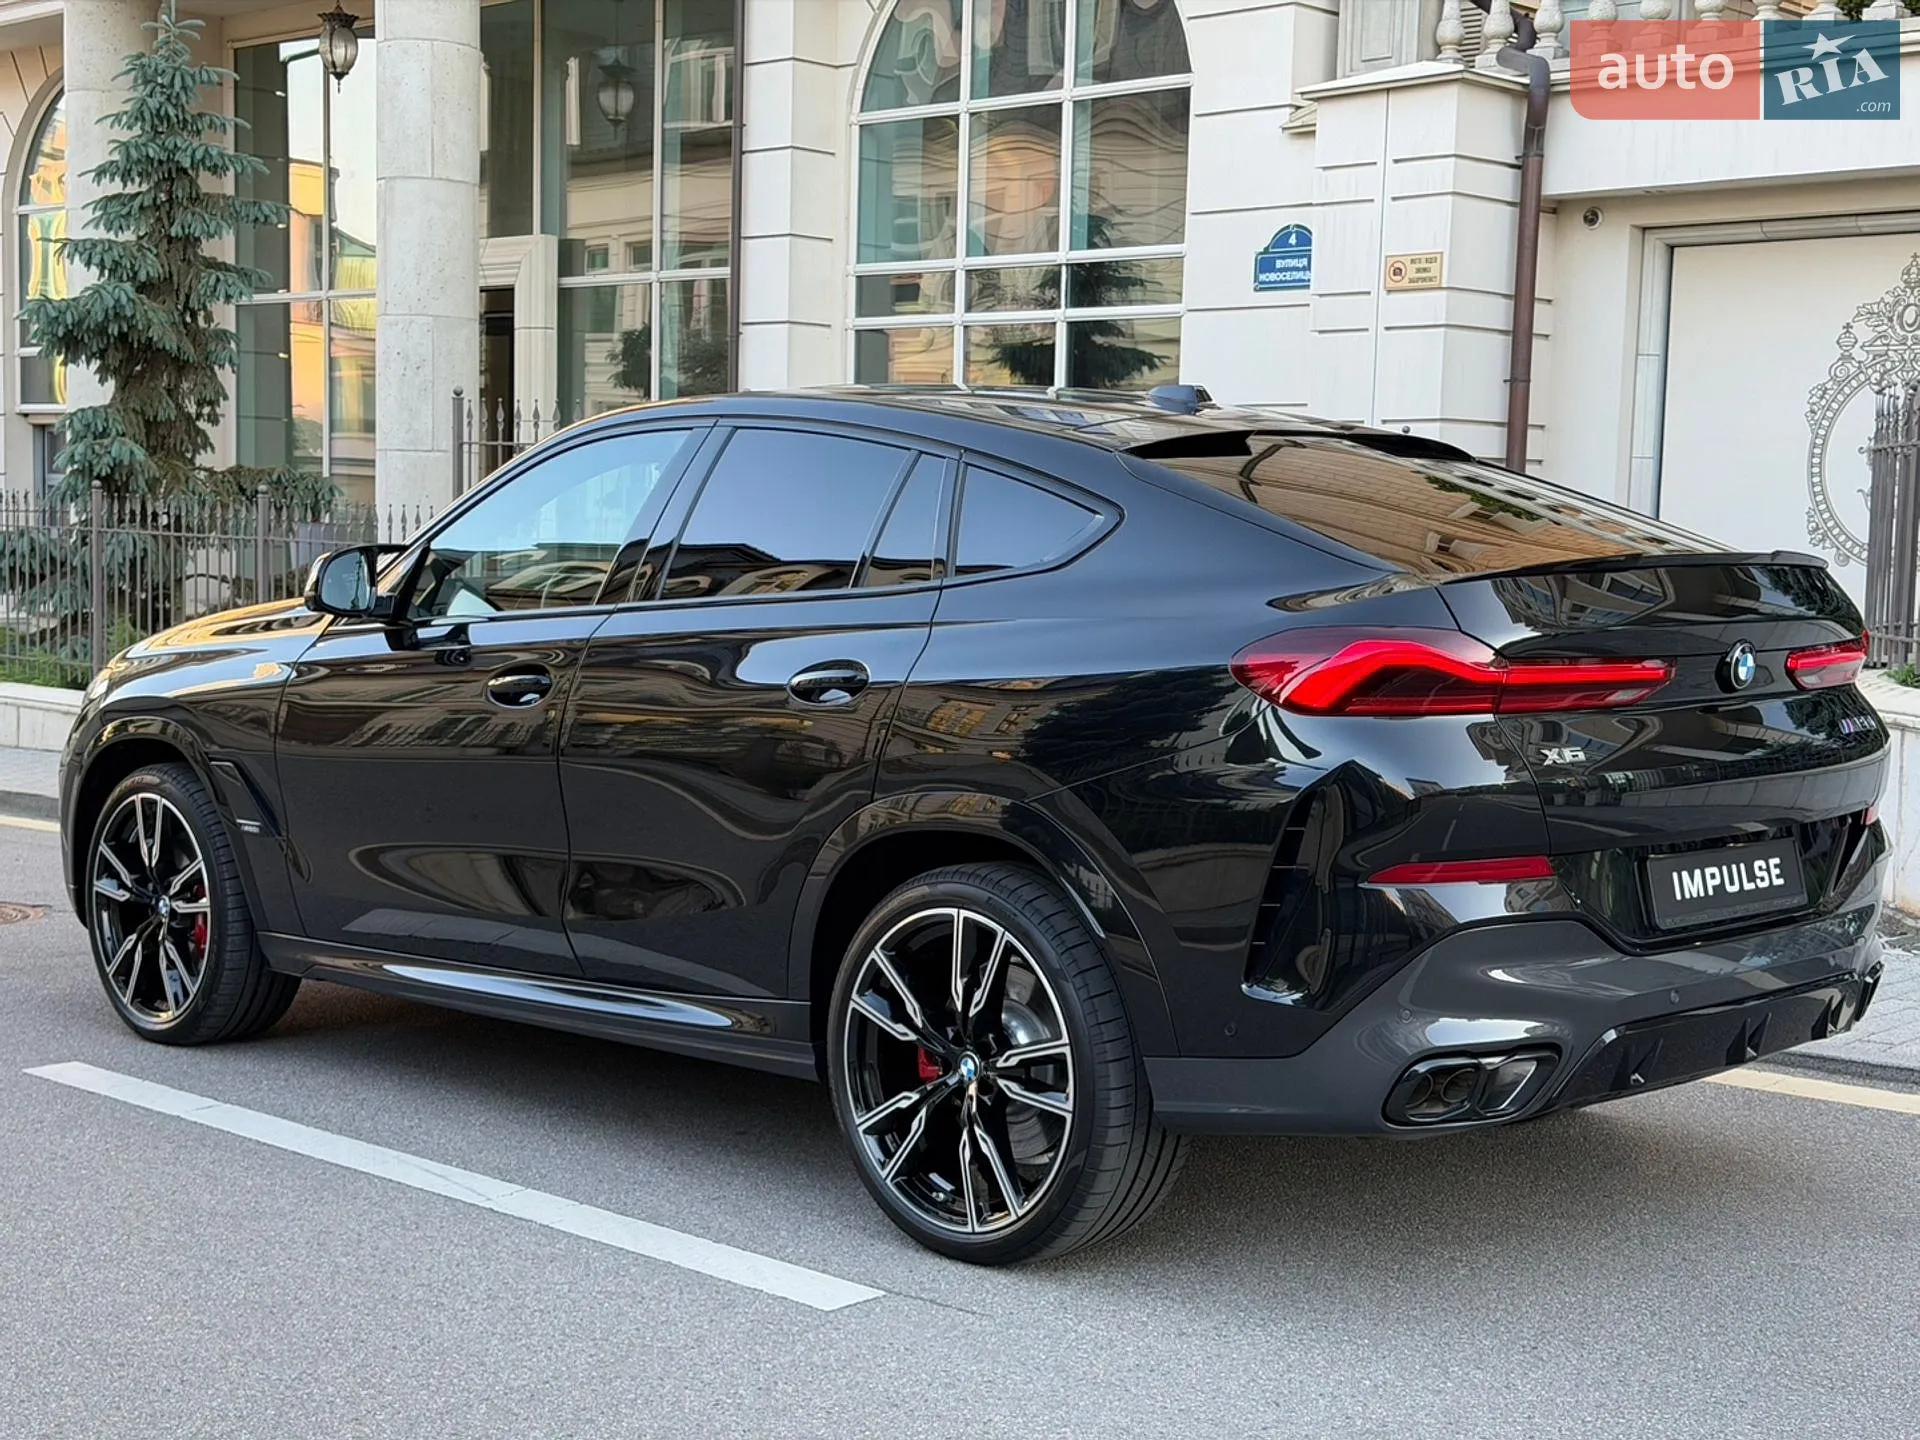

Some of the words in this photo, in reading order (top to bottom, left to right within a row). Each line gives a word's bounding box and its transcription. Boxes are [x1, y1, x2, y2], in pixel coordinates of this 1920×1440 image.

[1288, 232, 1297, 246] 4
[1275, 258, 1308, 269] ВУЛИЦЯ
[1540, 746, 1587, 766] X6
[1671, 857, 1785, 901] IMPULSE
